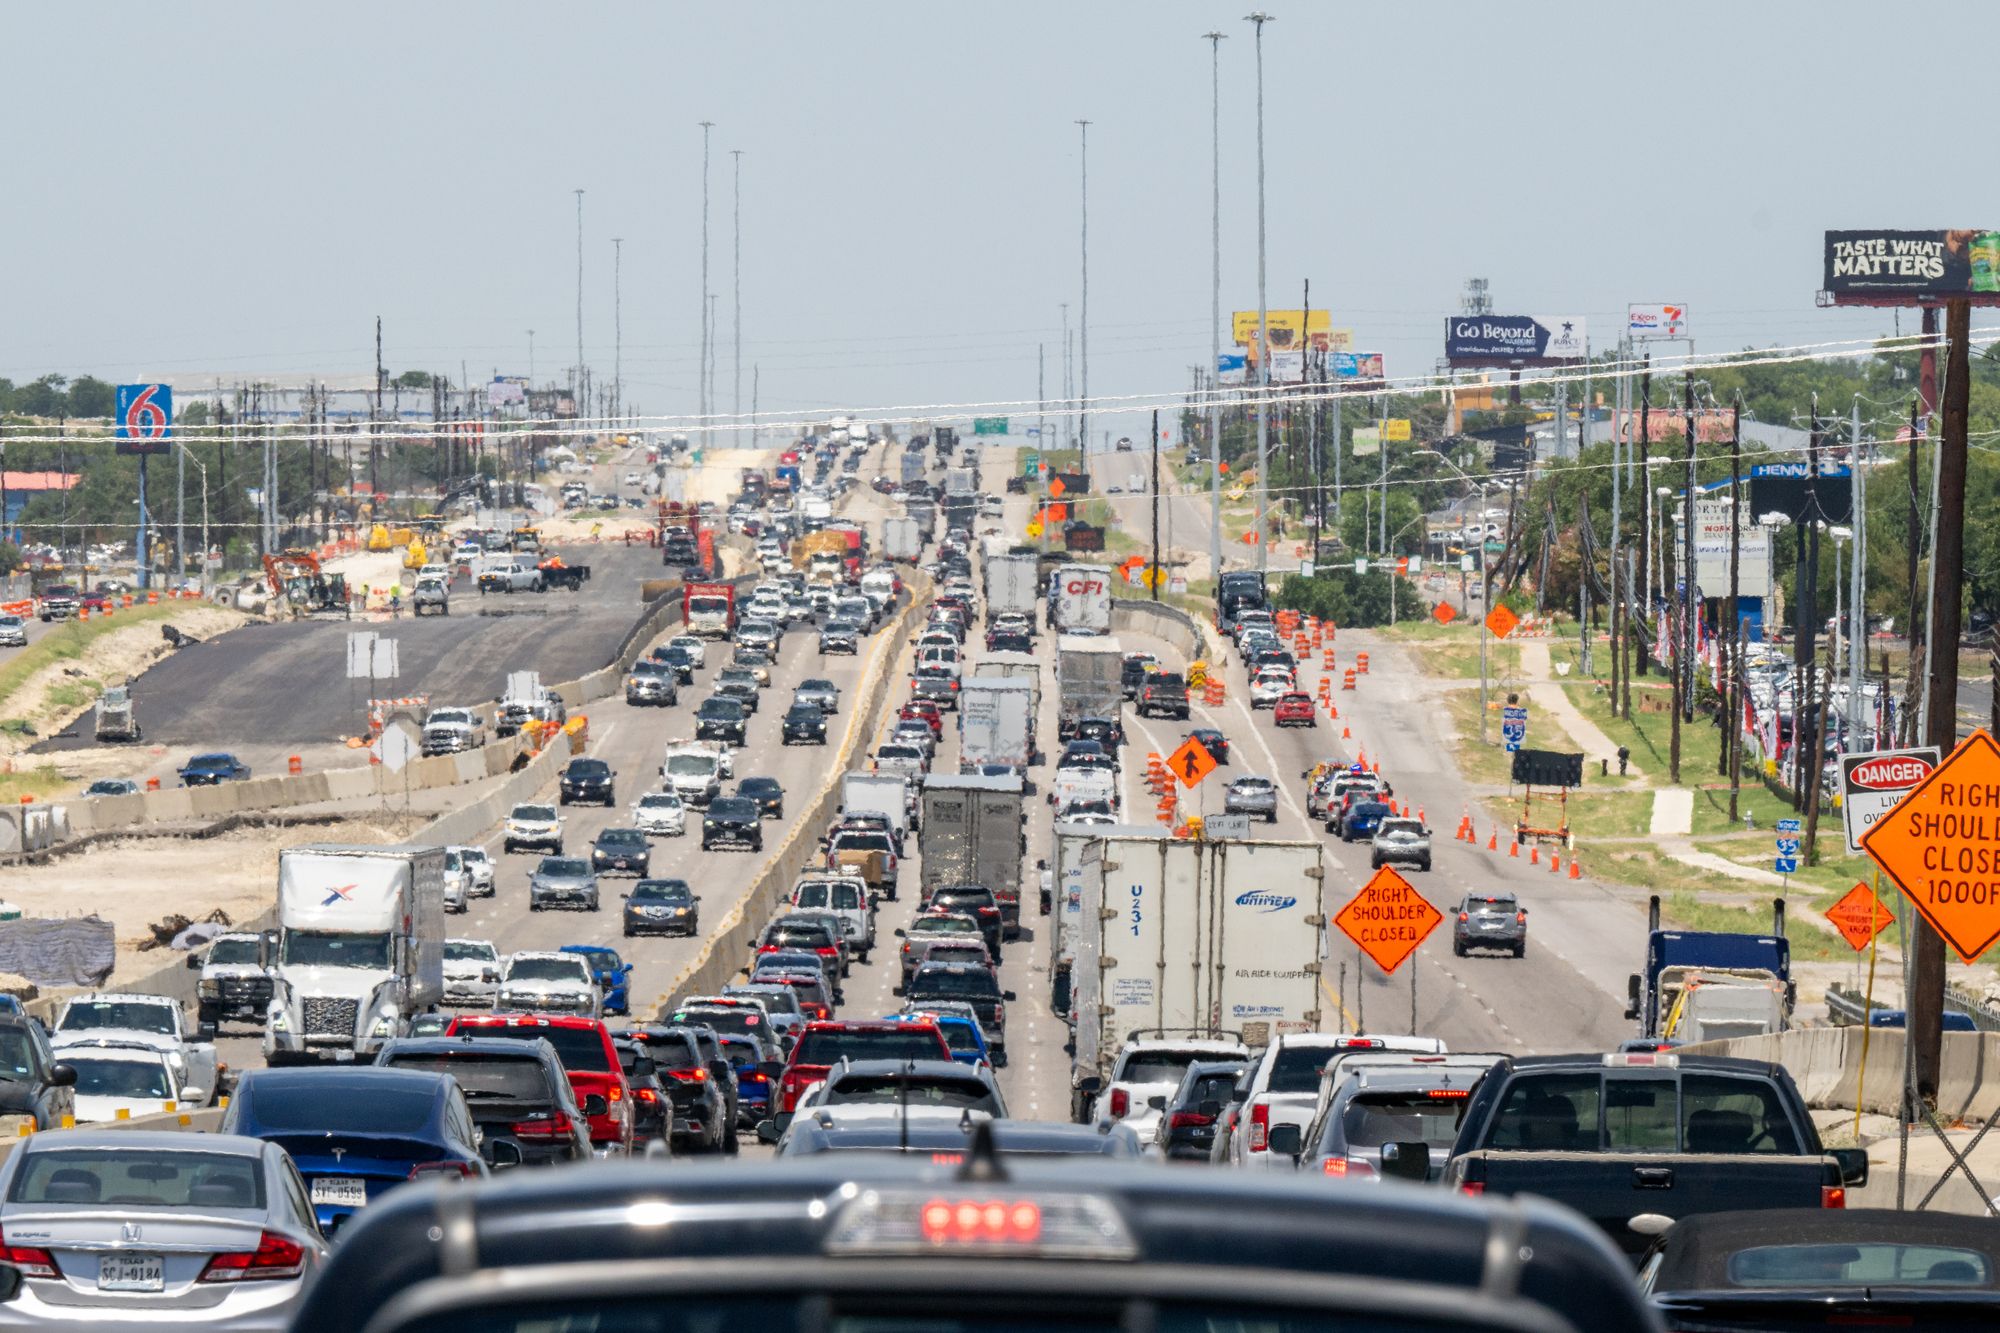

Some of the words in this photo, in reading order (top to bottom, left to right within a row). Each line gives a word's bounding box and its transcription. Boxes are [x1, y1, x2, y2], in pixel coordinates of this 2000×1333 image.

[1833, 238, 1887, 257] TASTE
[1890, 239, 1944, 258] WHAT
[1833, 255, 1945, 279] MATTERS
[1456, 322, 1480, 338] Go
[1483, 323, 1536, 343] Beyond
[126, 384, 166, 440] 6
[1067, 580, 1103, 596] CFI
[1505, 724, 1523, 738] 35
[1858, 762, 1925, 785] DANGER
[1367, 888, 1409, 903] RIGHT
[1353, 904, 1427, 921] SHOULDER
[1361, 926, 1416, 942] CLOSED
[1236, 969, 1250, 977] AIR
[1251, 970, 1271, 978] RIDE
[1274, 970, 1314, 979] EQUIPPED
